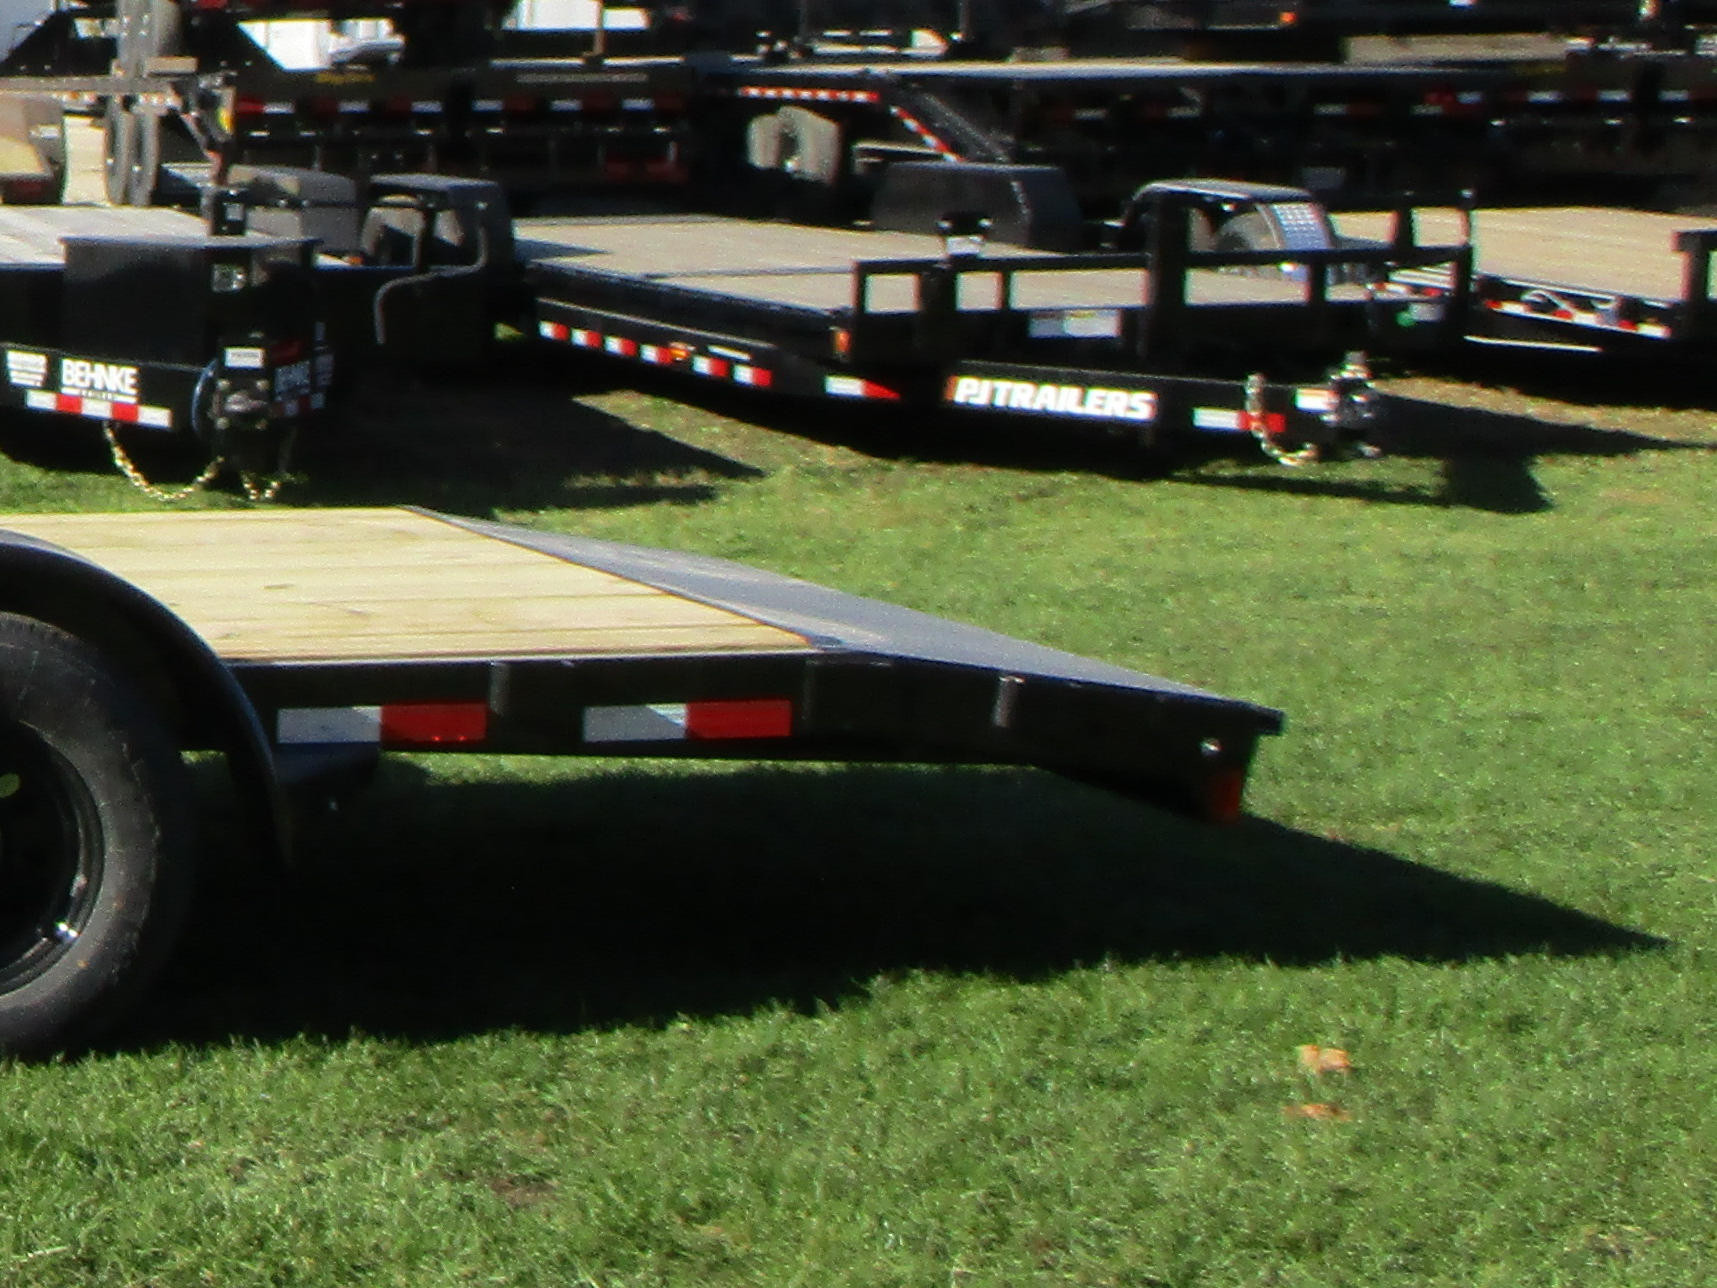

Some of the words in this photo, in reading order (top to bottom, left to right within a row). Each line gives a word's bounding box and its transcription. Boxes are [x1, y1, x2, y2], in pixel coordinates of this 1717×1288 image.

[61, 358, 138, 396] BEHNKE
[955, 377, 991, 404] PJ
[993, 381, 1157, 420] TRAILERS
